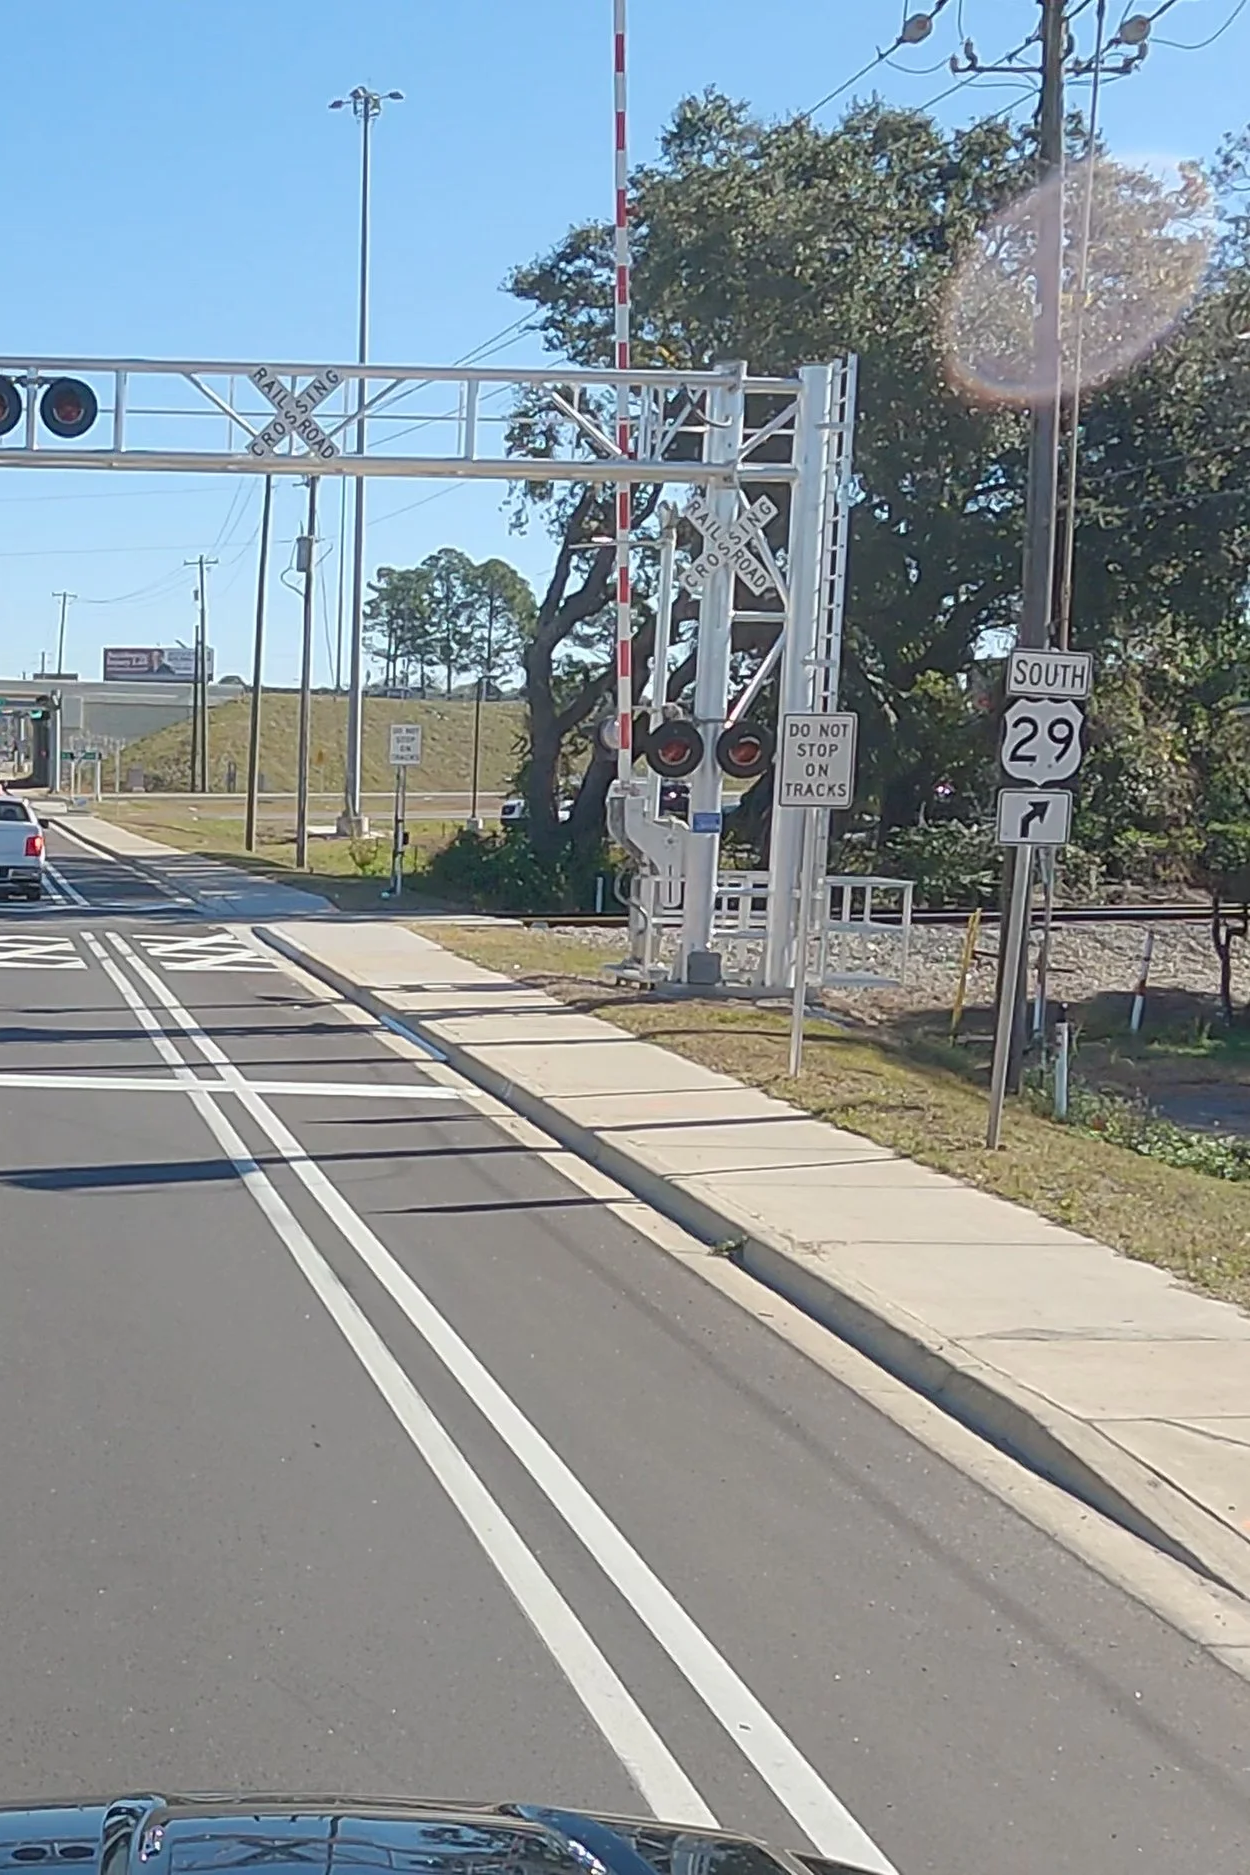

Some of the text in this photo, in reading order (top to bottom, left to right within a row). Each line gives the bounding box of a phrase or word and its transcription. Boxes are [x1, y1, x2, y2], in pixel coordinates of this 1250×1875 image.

[251, 369, 339, 457] CROSSING
[685, 501, 772, 588] CROSSING
[1013, 659, 1085, 689] SOUTH
[789, 723, 849, 738] DO NOT
[1008, 715, 1075, 763] 29
[796, 743, 839, 757] STOP
[805, 763, 829, 777] ON
[785, 783, 847, 797] TRACKS
